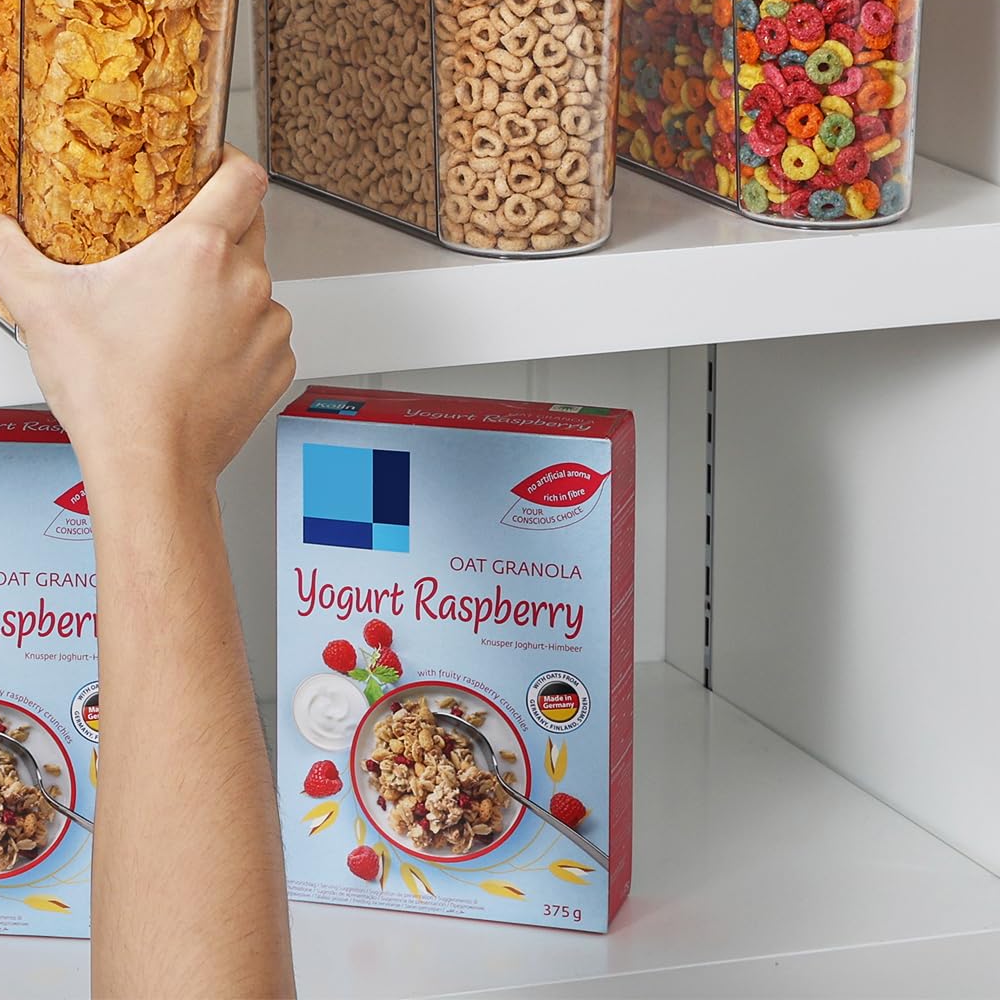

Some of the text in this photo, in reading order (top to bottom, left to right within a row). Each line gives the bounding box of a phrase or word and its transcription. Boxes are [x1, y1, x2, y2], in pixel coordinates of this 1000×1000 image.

[404, 408, 592, 432] Yogurt Raspberry
[527, 470, 591, 494] no artificial aroma
[70, 494, 80, 504] no
[544, 493, 558, 502] rich
[568, 488, 586, 500] fibre
[512, 506, 584, 524] CONSCIOUS CHOICE
[522, 507, 544, 516] YOUR
[66, 518, 88, 526] YOUR
[450, 556, 582, 580] OAT GRANOLA
[294, 567, 584, 640] Yogurt Raspberry
[480, 638, 583, 652] Knusper Joghurt-Himbeer
[24, 652, 56, 660] Knusper
[533, 676, 546, 690] WITH
[562, 674, 580, 687] FROM
[78, 687, 91, 700] WITH
[416, 669, 529, 733] with fruity raspberry crunchies
[6, 692, 44, 714] raspberry
[44, 710, 73, 745] crunchies
[544, 904, 582, 922] 375 g
